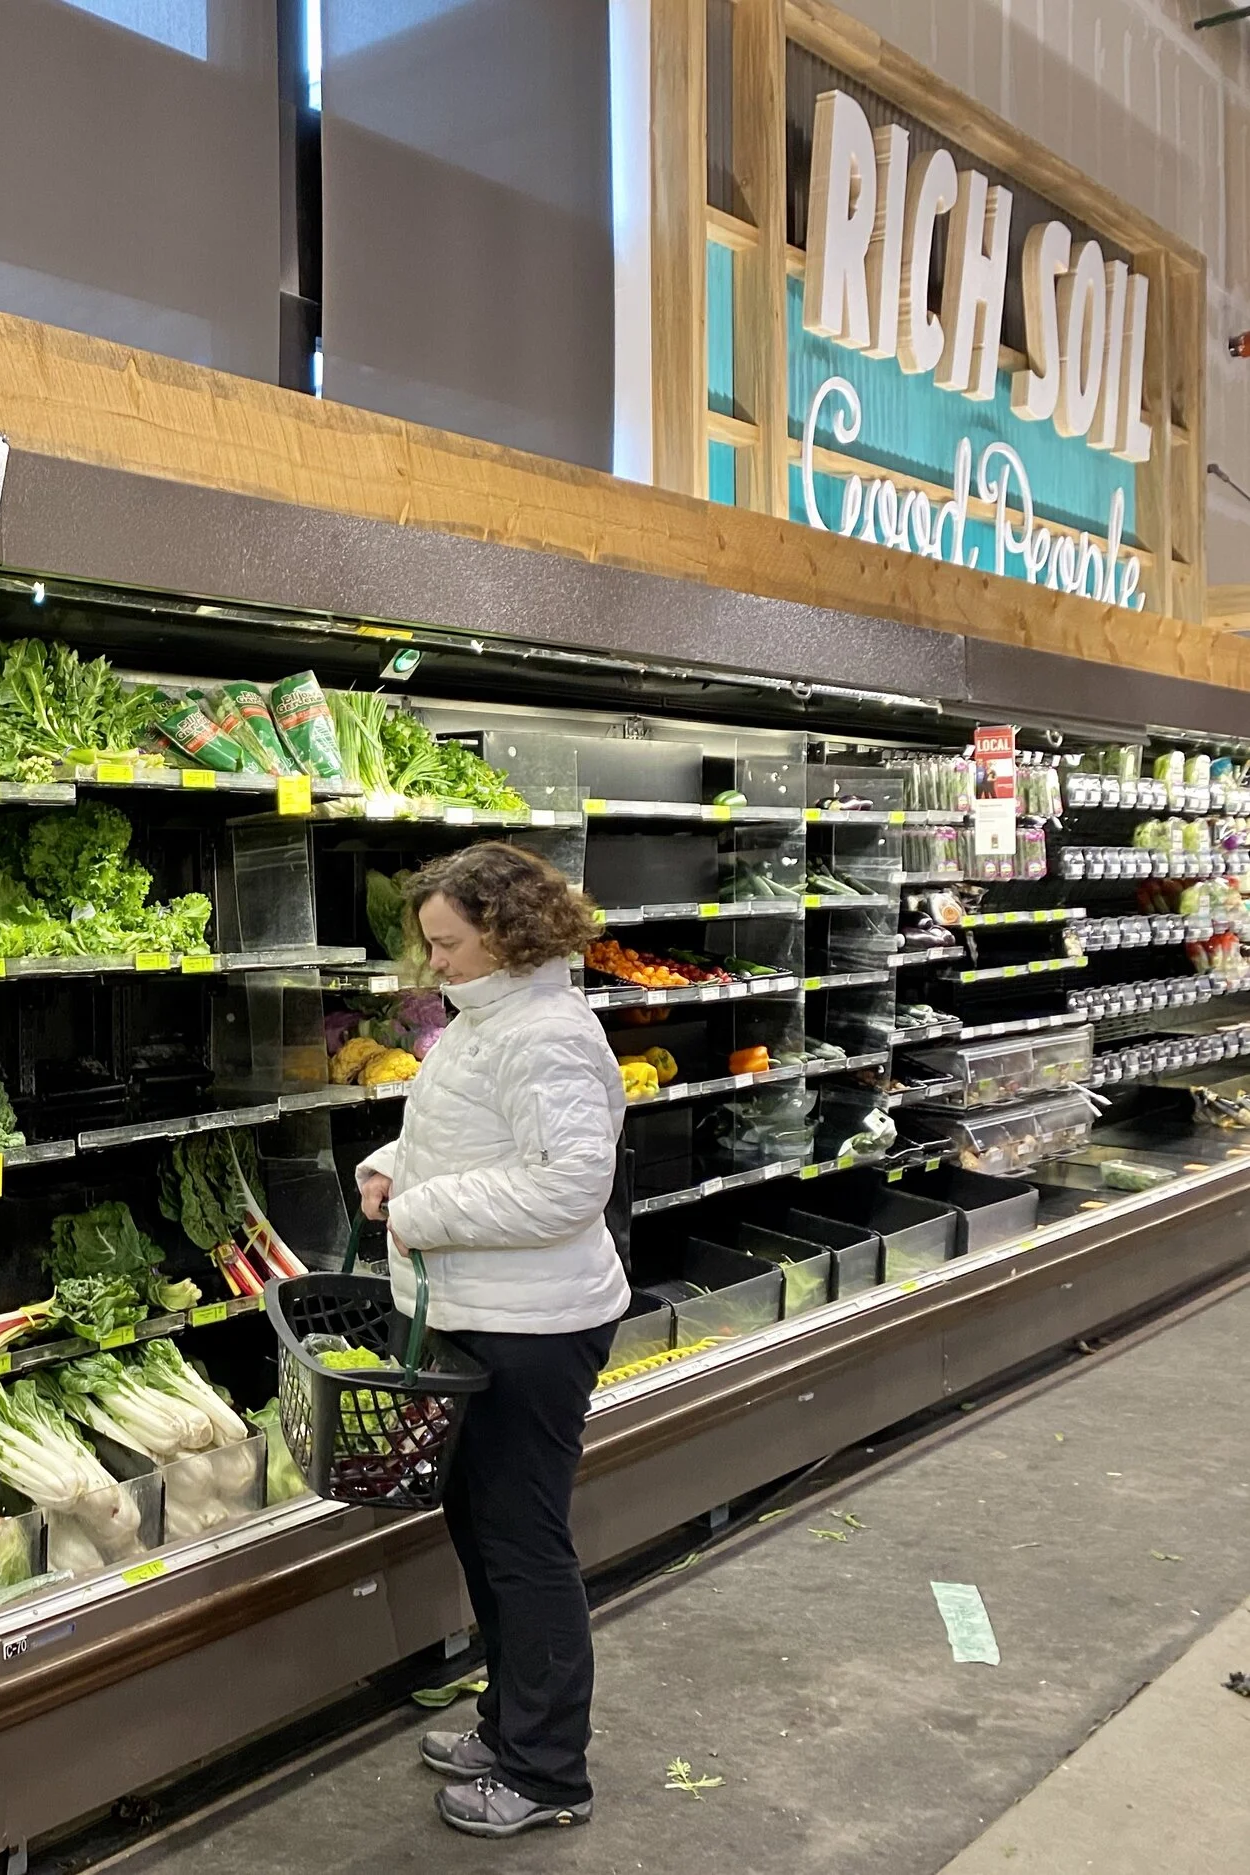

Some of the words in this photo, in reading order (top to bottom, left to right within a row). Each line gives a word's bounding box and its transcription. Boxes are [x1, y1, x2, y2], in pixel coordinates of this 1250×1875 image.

[803, 89, 1013, 402] RICH
[1010, 220, 1152, 463] SOIL
[802, 376, 979, 569] Good
[977, 441, 1146, 612] People
[977, 738, 1011, 752] LOCAL
[6, 1640, 28, 1658] C-70
